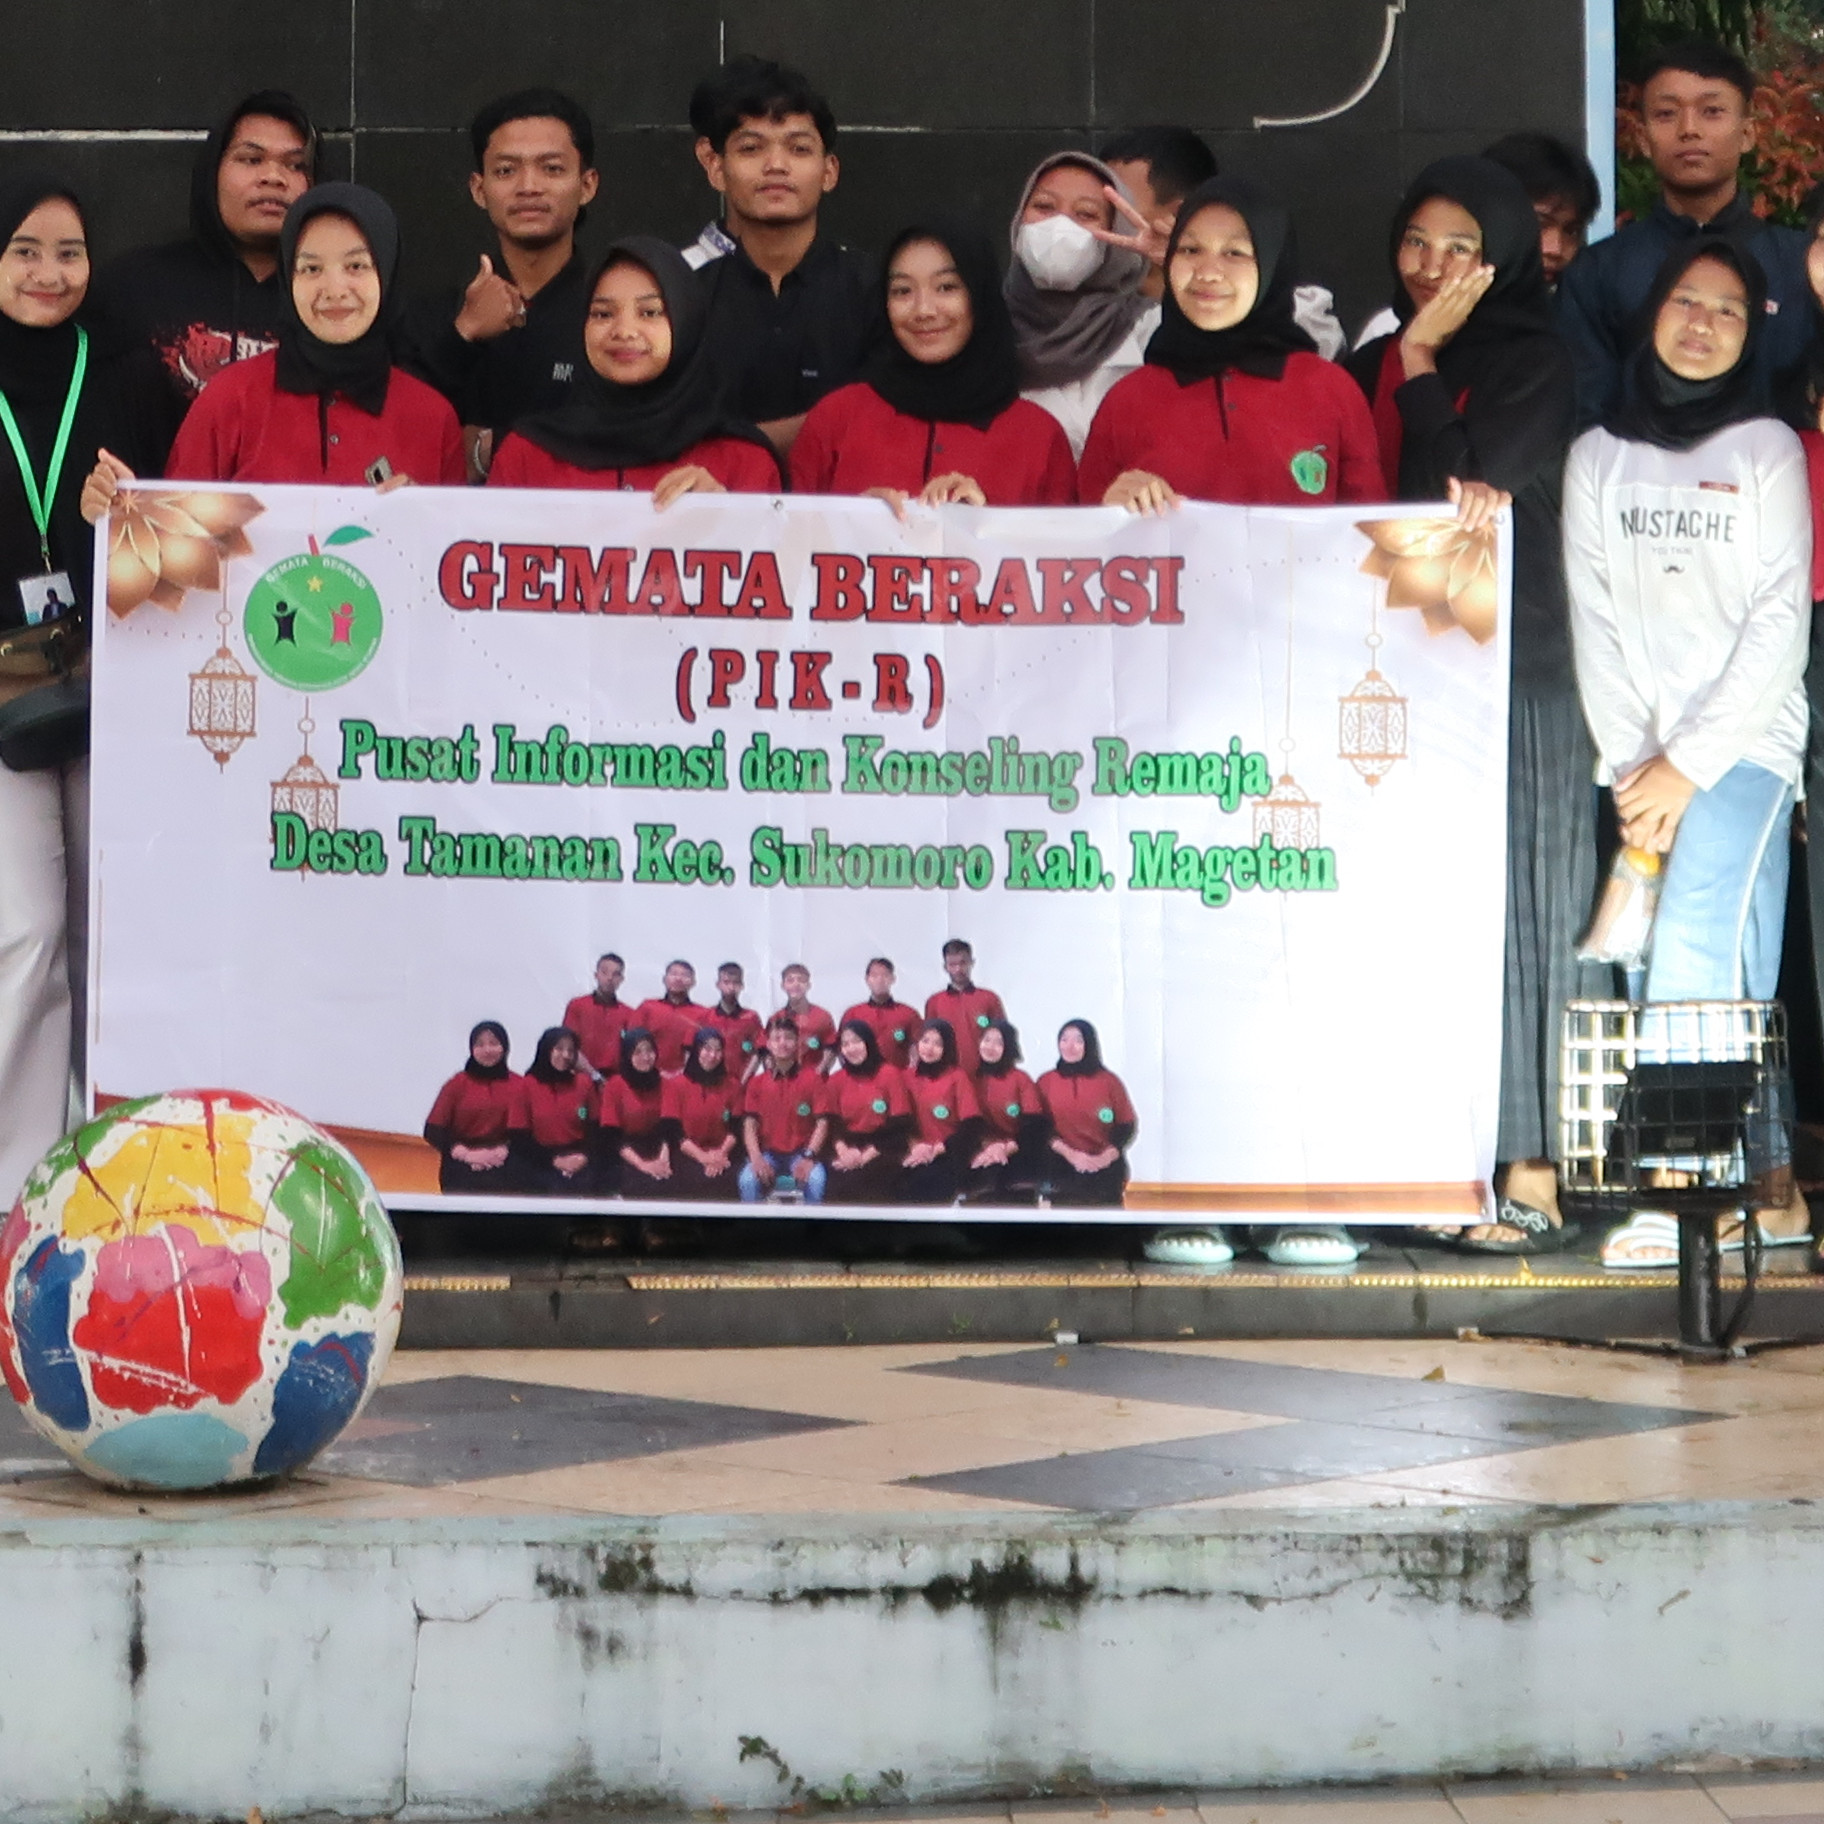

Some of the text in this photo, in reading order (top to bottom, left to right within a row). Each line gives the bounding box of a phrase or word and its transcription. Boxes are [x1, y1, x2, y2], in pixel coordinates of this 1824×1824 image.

[438, 539, 1185, 627] GEMATA BERAKSI
[337, 718, 1273, 814] Pusat Informasi dan Konseling Remaja
[270, 811, 1340, 908] Desa Tamanan Kec. Sukomoro Kab. Magetan
